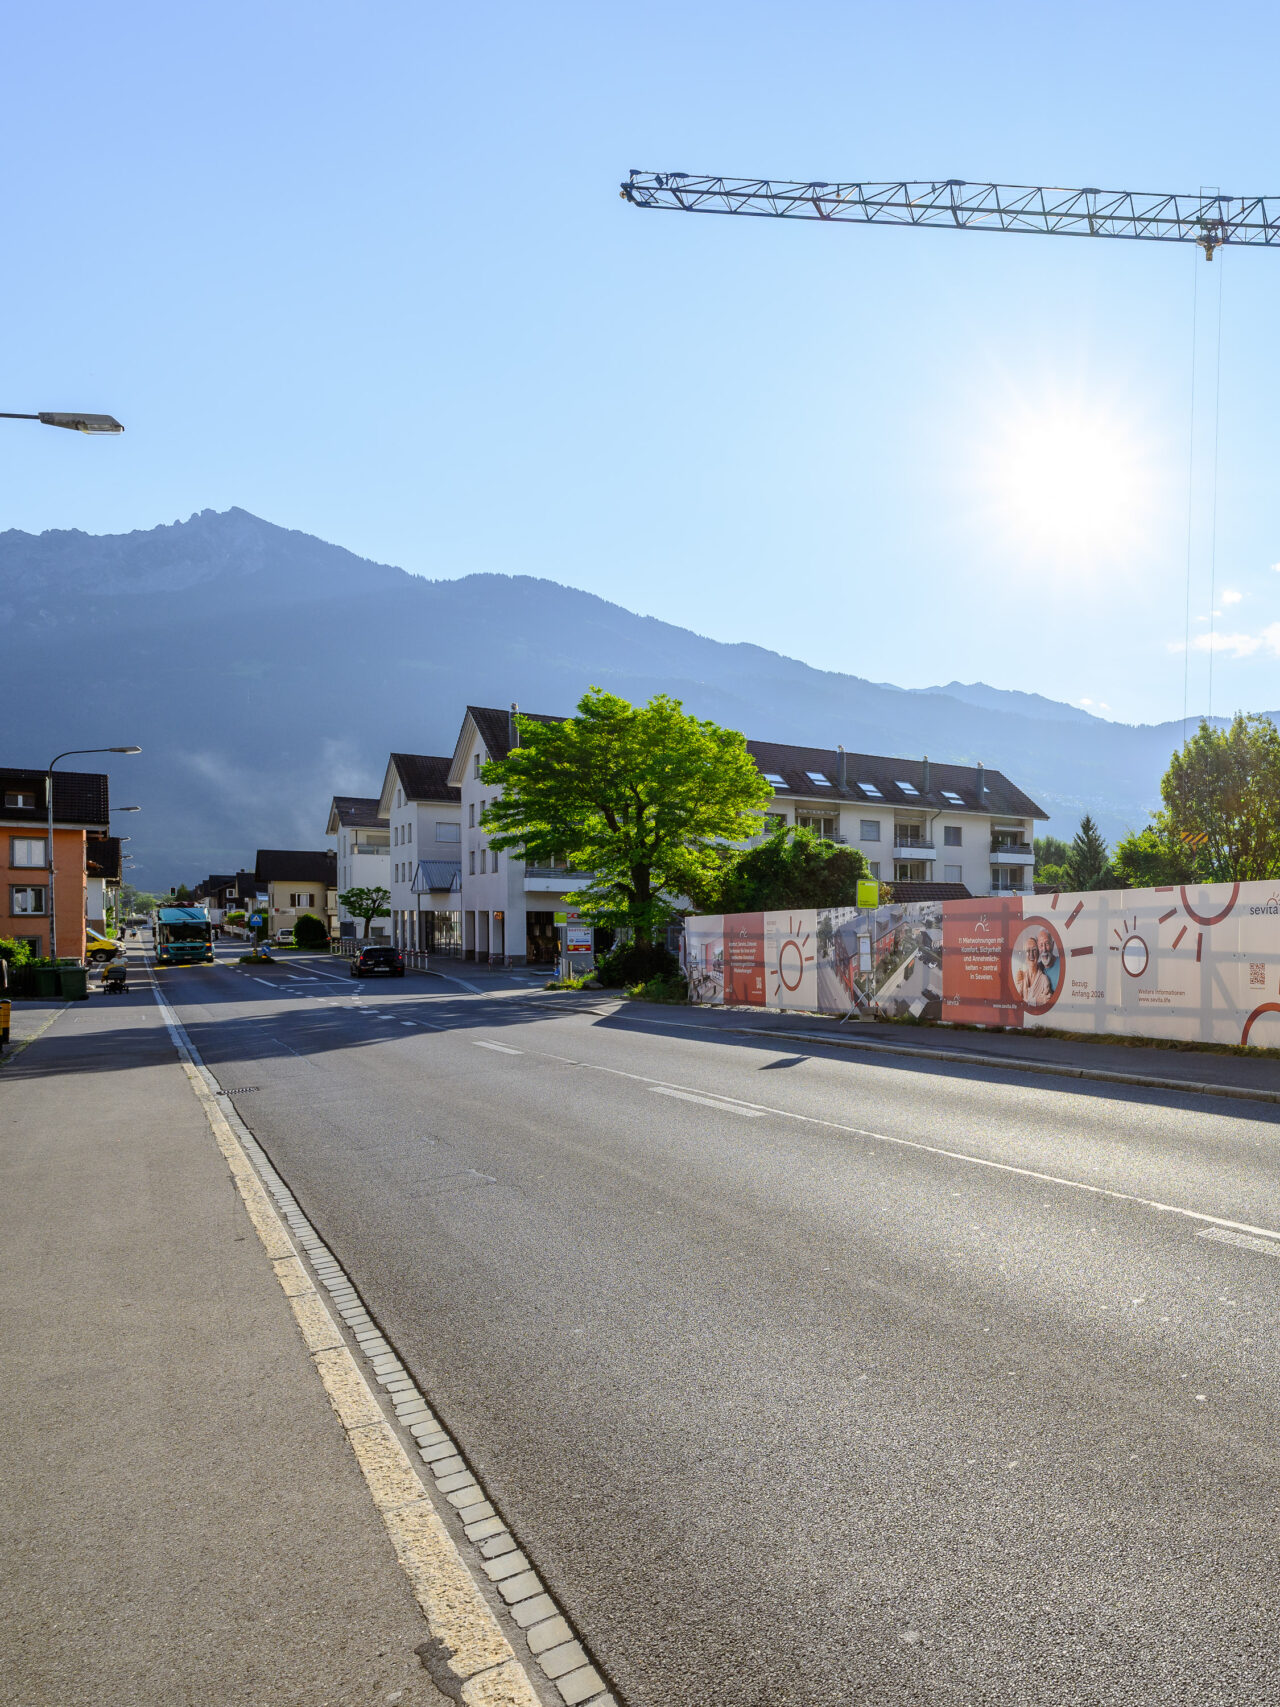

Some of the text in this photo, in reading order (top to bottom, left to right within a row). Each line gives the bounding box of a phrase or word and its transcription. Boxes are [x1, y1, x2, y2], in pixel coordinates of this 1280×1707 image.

[1250, 905, 1279, 915] sevita
[963, 937, 997, 946] Mietwohnungen
[1071, 990, 1105, 1000] Anfang 2026
